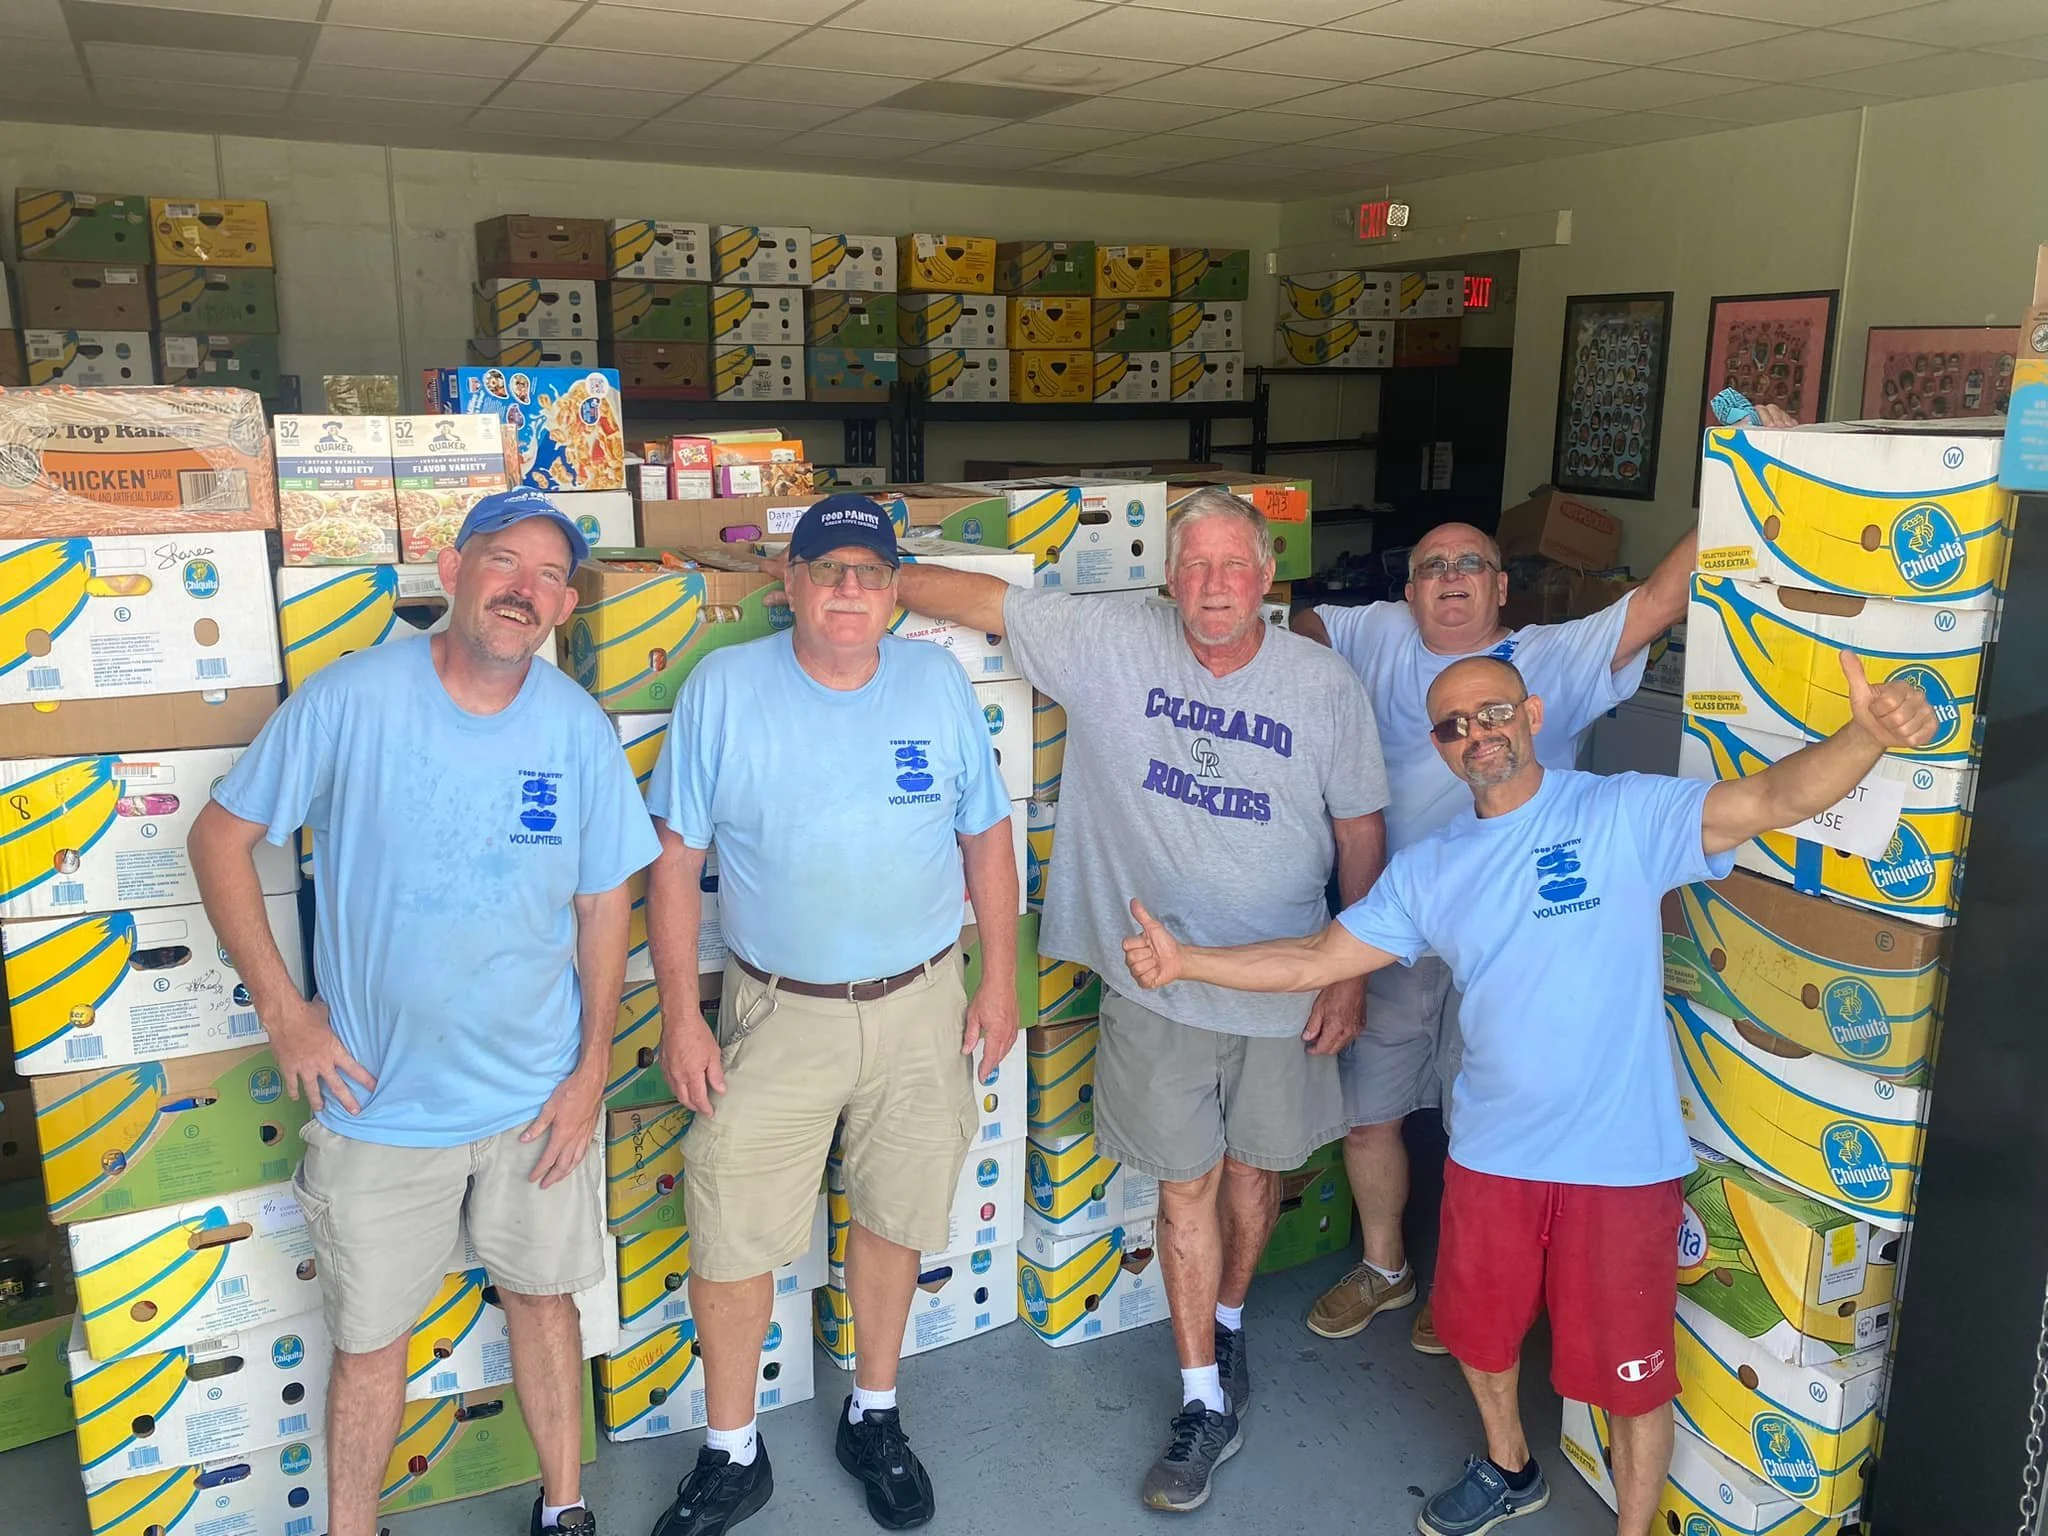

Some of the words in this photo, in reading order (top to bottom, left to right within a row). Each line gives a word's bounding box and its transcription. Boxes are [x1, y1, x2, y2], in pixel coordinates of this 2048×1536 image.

[1360, 202, 1389, 239] EXIT
[1464, 276, 1492, 307] EXIT
[62, 424, 110, 444] Top
[280, 421, 299, 438] 52
[395, 421, 414, 438] 52
[314, 443, 354, 453] QUAKER
[428, 441, 466, 452] QUAKER
[297, 466, 332, 474] FLAVOR
[335, 466, 374, 474] VARIETY
[412, 464, 446, 473] FLAVOR
[448, 463, 487, 472] VARIETY
[49, 469, 146, 491] CHICKEN
[147, 469, 173, 480] FLAVOR
[821, 511, 843, 523] FOOD
[845, 510, 880, 525] PANTRY
[1704, 560, 1726, 569] CLASS
[1727, 558, 1750, 567] EXTRA
[1901, 540, 1964, 582] Chiquita
[185, 580, 218, 591] Chiquita
[905, 630, 929, 639] TRADER
[1694, 702, 1716, 710] CLASS
[1716, 702, 1740, 711] EXTRA
[1145, 687, 1293, 758] COLORADO
[1142, 758, 1272, 822] ROCKIES
[1846, 786, 1868, 803] OT
[888, 793, 942, 806] VOLUNTEER
[1813, 811, 1844, 831] USE
[509, 833, 563, 846] VOLUNTEER
[1871, 855, 1934, 888] Chiquita
[1532, 897, 1601, 919] VOLUNTEER
[1832, 1019, 1890, 1046] Chiquita
[251, 1082, 282, 1098] Chiquita
[1831, 1164, 1890, 1188] Chiquita
[273, 1350, 304, 1365] Chiquita
[1762, 1458, 1818, 1480] Chiquita
